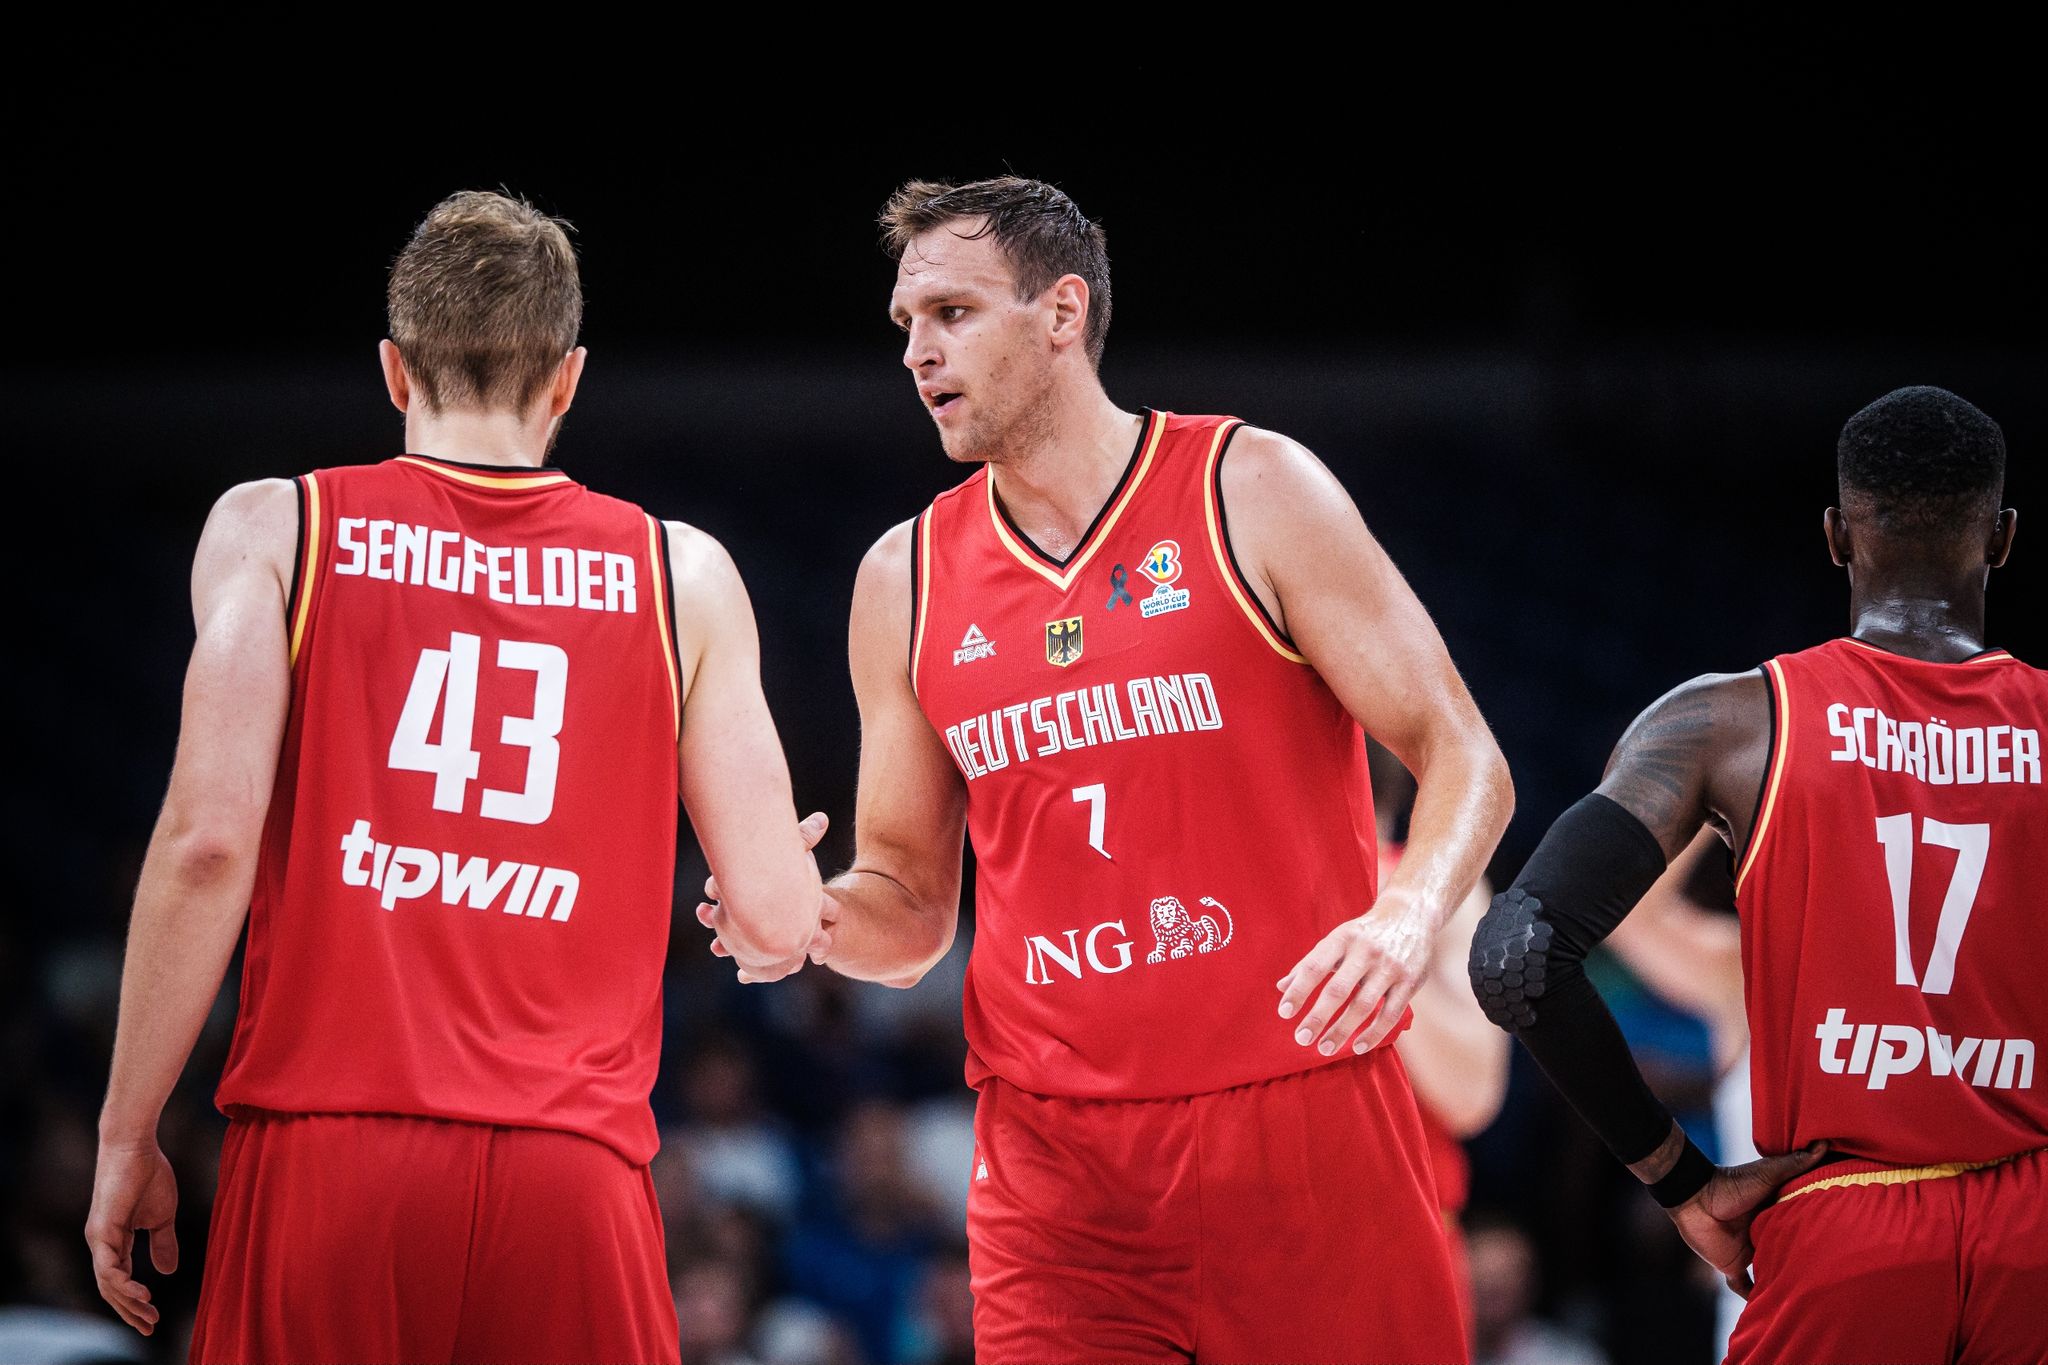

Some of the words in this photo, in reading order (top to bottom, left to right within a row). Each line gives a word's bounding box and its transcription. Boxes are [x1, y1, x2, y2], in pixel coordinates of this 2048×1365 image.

[335, 516, 638, 613] SENGFELDER
[1143, 598, 1170, 610] WORLD
[1171, 594, 1187, 603] CUP
[1144, 601, 1187, 616] QUALIFIERS
[953, 640, 997, 666] PEAK
[387, 631, 569, 825] 43
[945, 672, 1223, 780] DEUTSCHLAND
[1826, 702, 2042, 785] SCHRÖDER
[1071, 783, 1112, 859] 7
[1874, 812, 1991, 995] 17
[1023, 919, 1134, 985] ING
